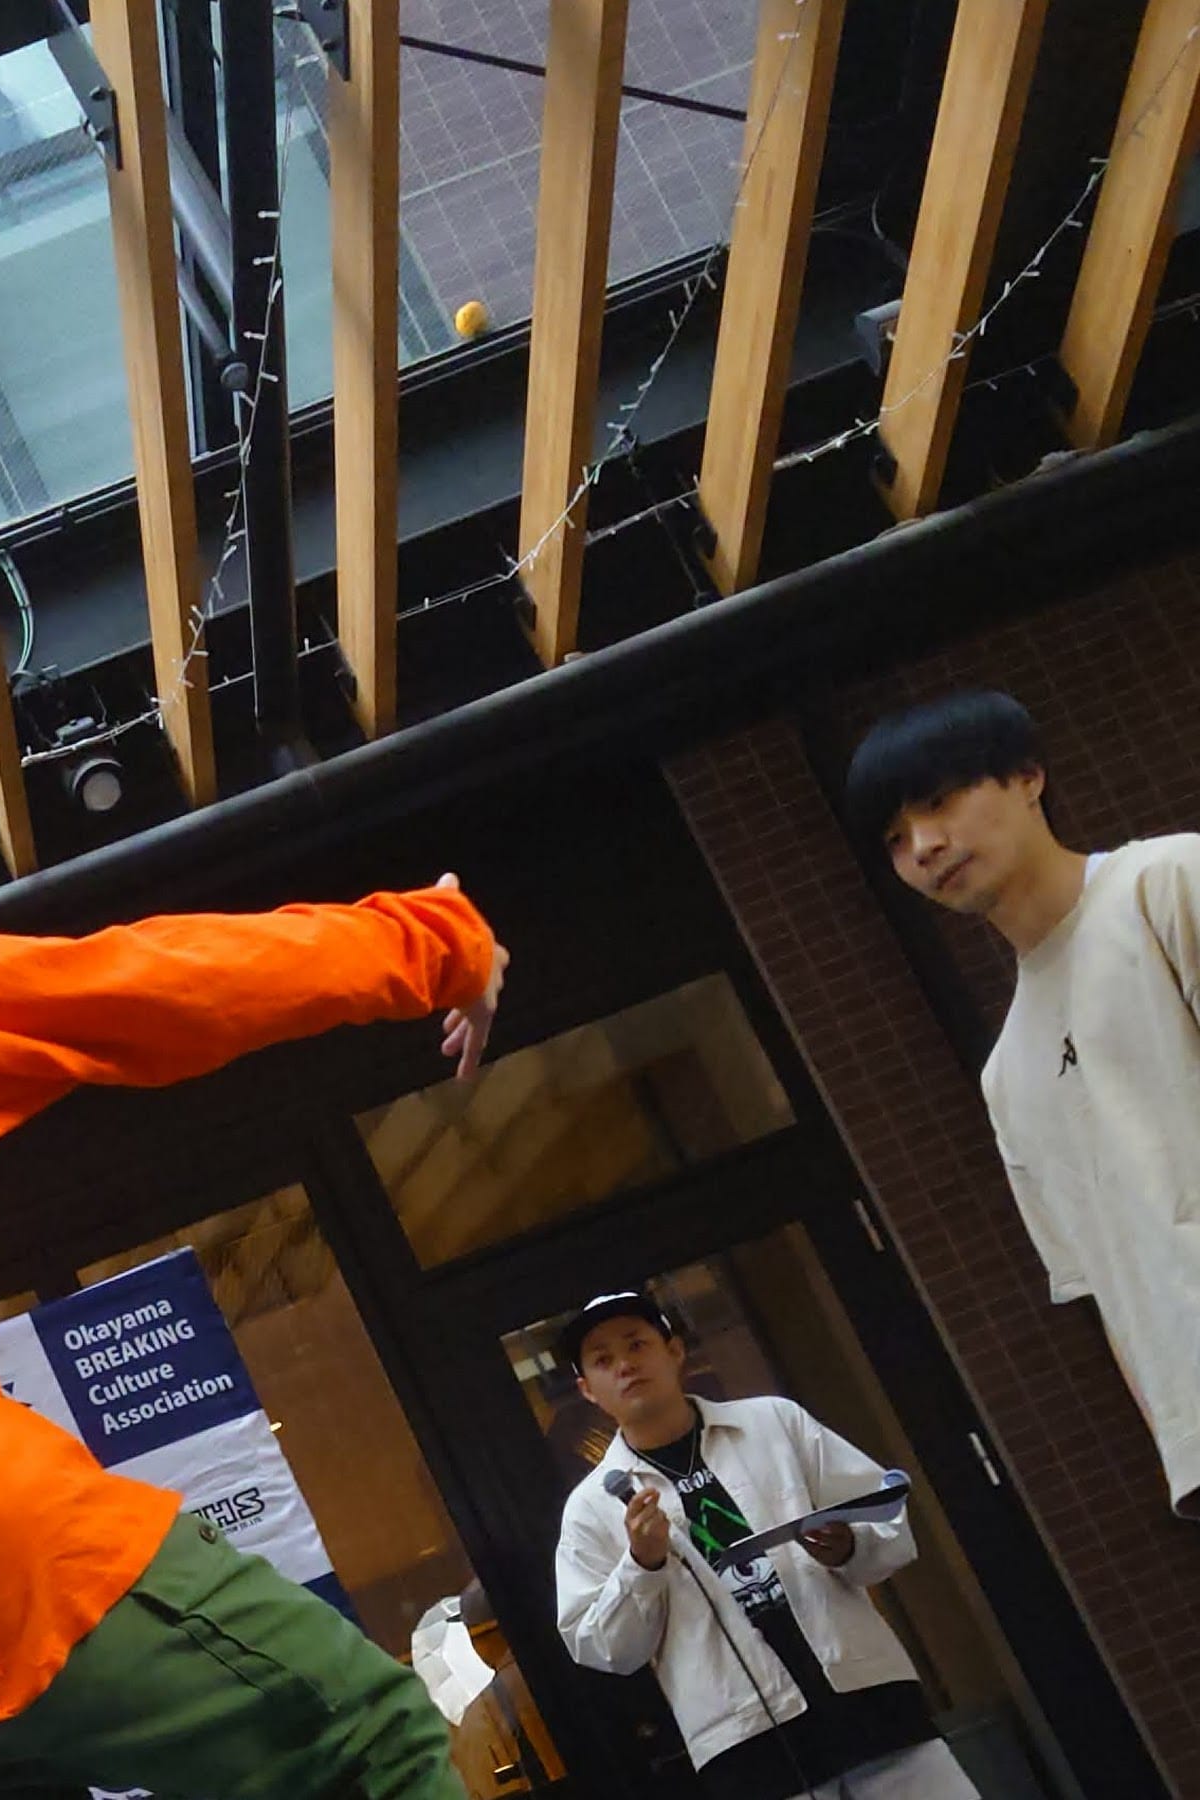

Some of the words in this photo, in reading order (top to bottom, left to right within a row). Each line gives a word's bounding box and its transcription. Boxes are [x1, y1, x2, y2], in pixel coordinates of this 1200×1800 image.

[64, 1299, 173, 1350] Okayama
[75, 1318, 195, 1379] BREAKING
[89, 1363, 175, 1405] Culture
[102, 1373, 234, 1435] Association
[190, 1487, 265, 1528] HS
